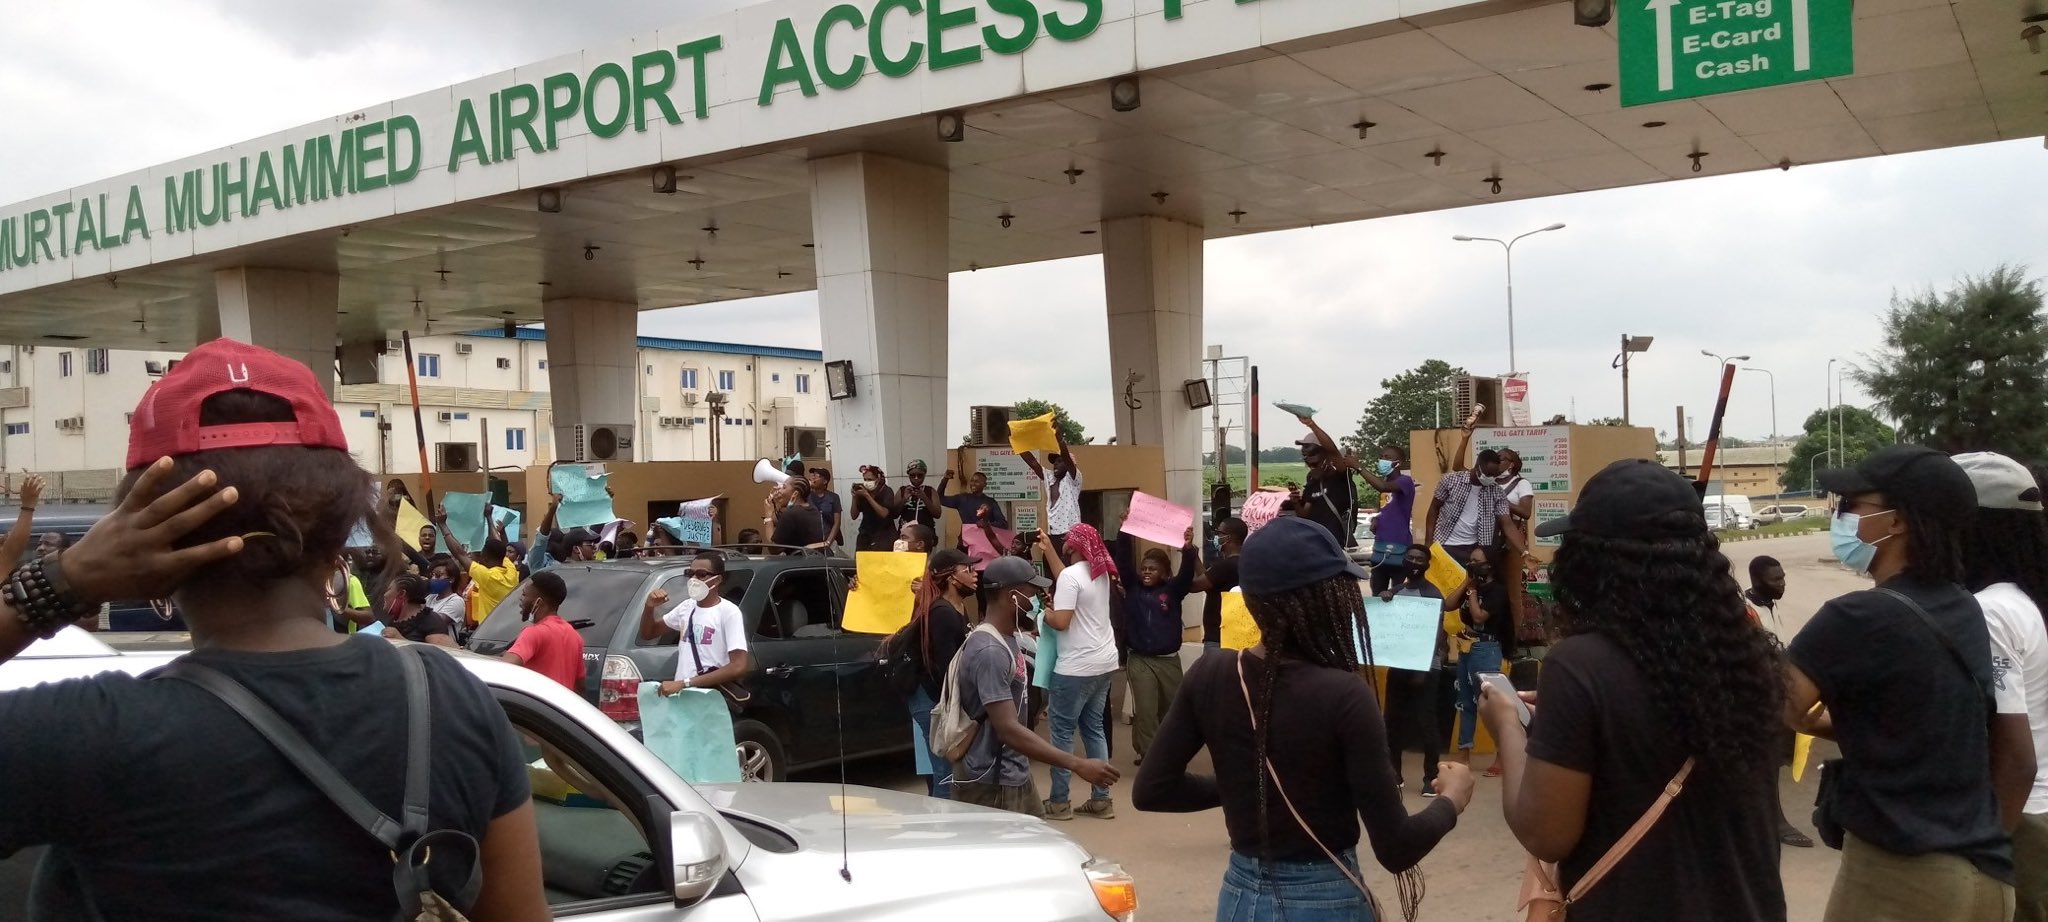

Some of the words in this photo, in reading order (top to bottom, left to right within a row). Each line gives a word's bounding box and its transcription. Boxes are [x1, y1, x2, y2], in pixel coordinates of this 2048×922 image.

[1689, 0, 1773, 25] E-Tag
[1682, 23, 1781, 54] E-Card
[1695, 54, 1769, 79] Cash
[164, 114, 422, 234] MUHAMMED
[447, 38, 724, 173] AIRPORT
